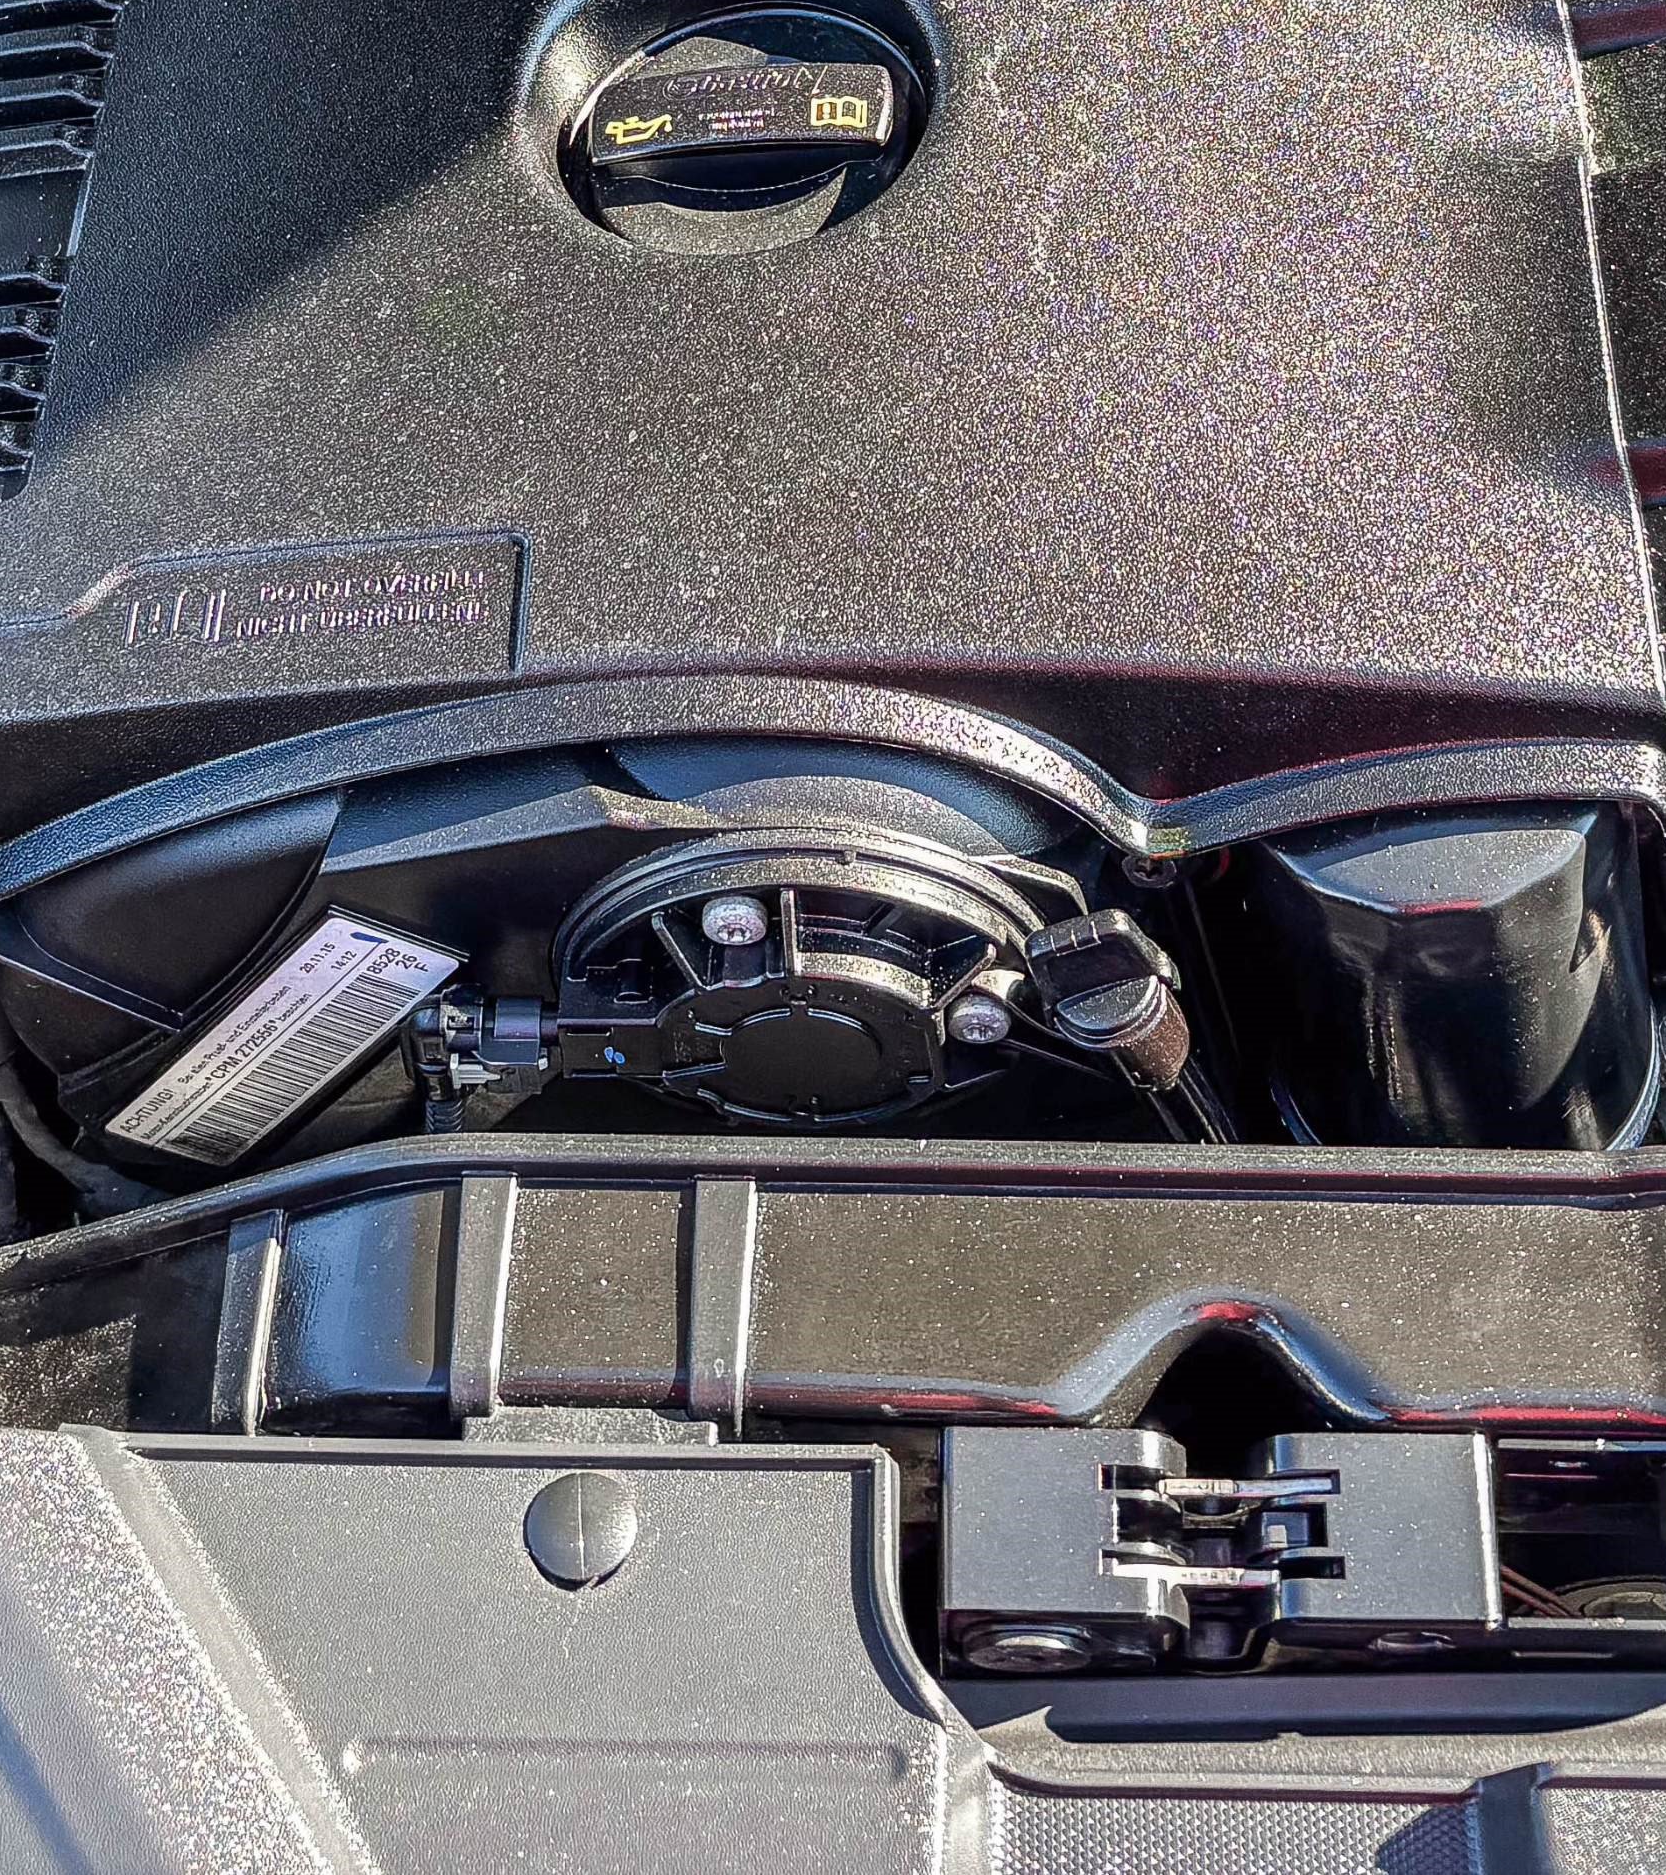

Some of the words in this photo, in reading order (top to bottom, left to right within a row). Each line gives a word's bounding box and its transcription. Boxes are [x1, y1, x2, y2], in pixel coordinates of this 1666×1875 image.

[260, 582, 294, 603] DO
[304, 578, 355, 599] NOT
[369, 946, 402, 975] 8528
[396, 953, 418, 970] 26
[415, 961, 430, 973] F
[123, 1088, 177, 1133] ACHTUNG!
